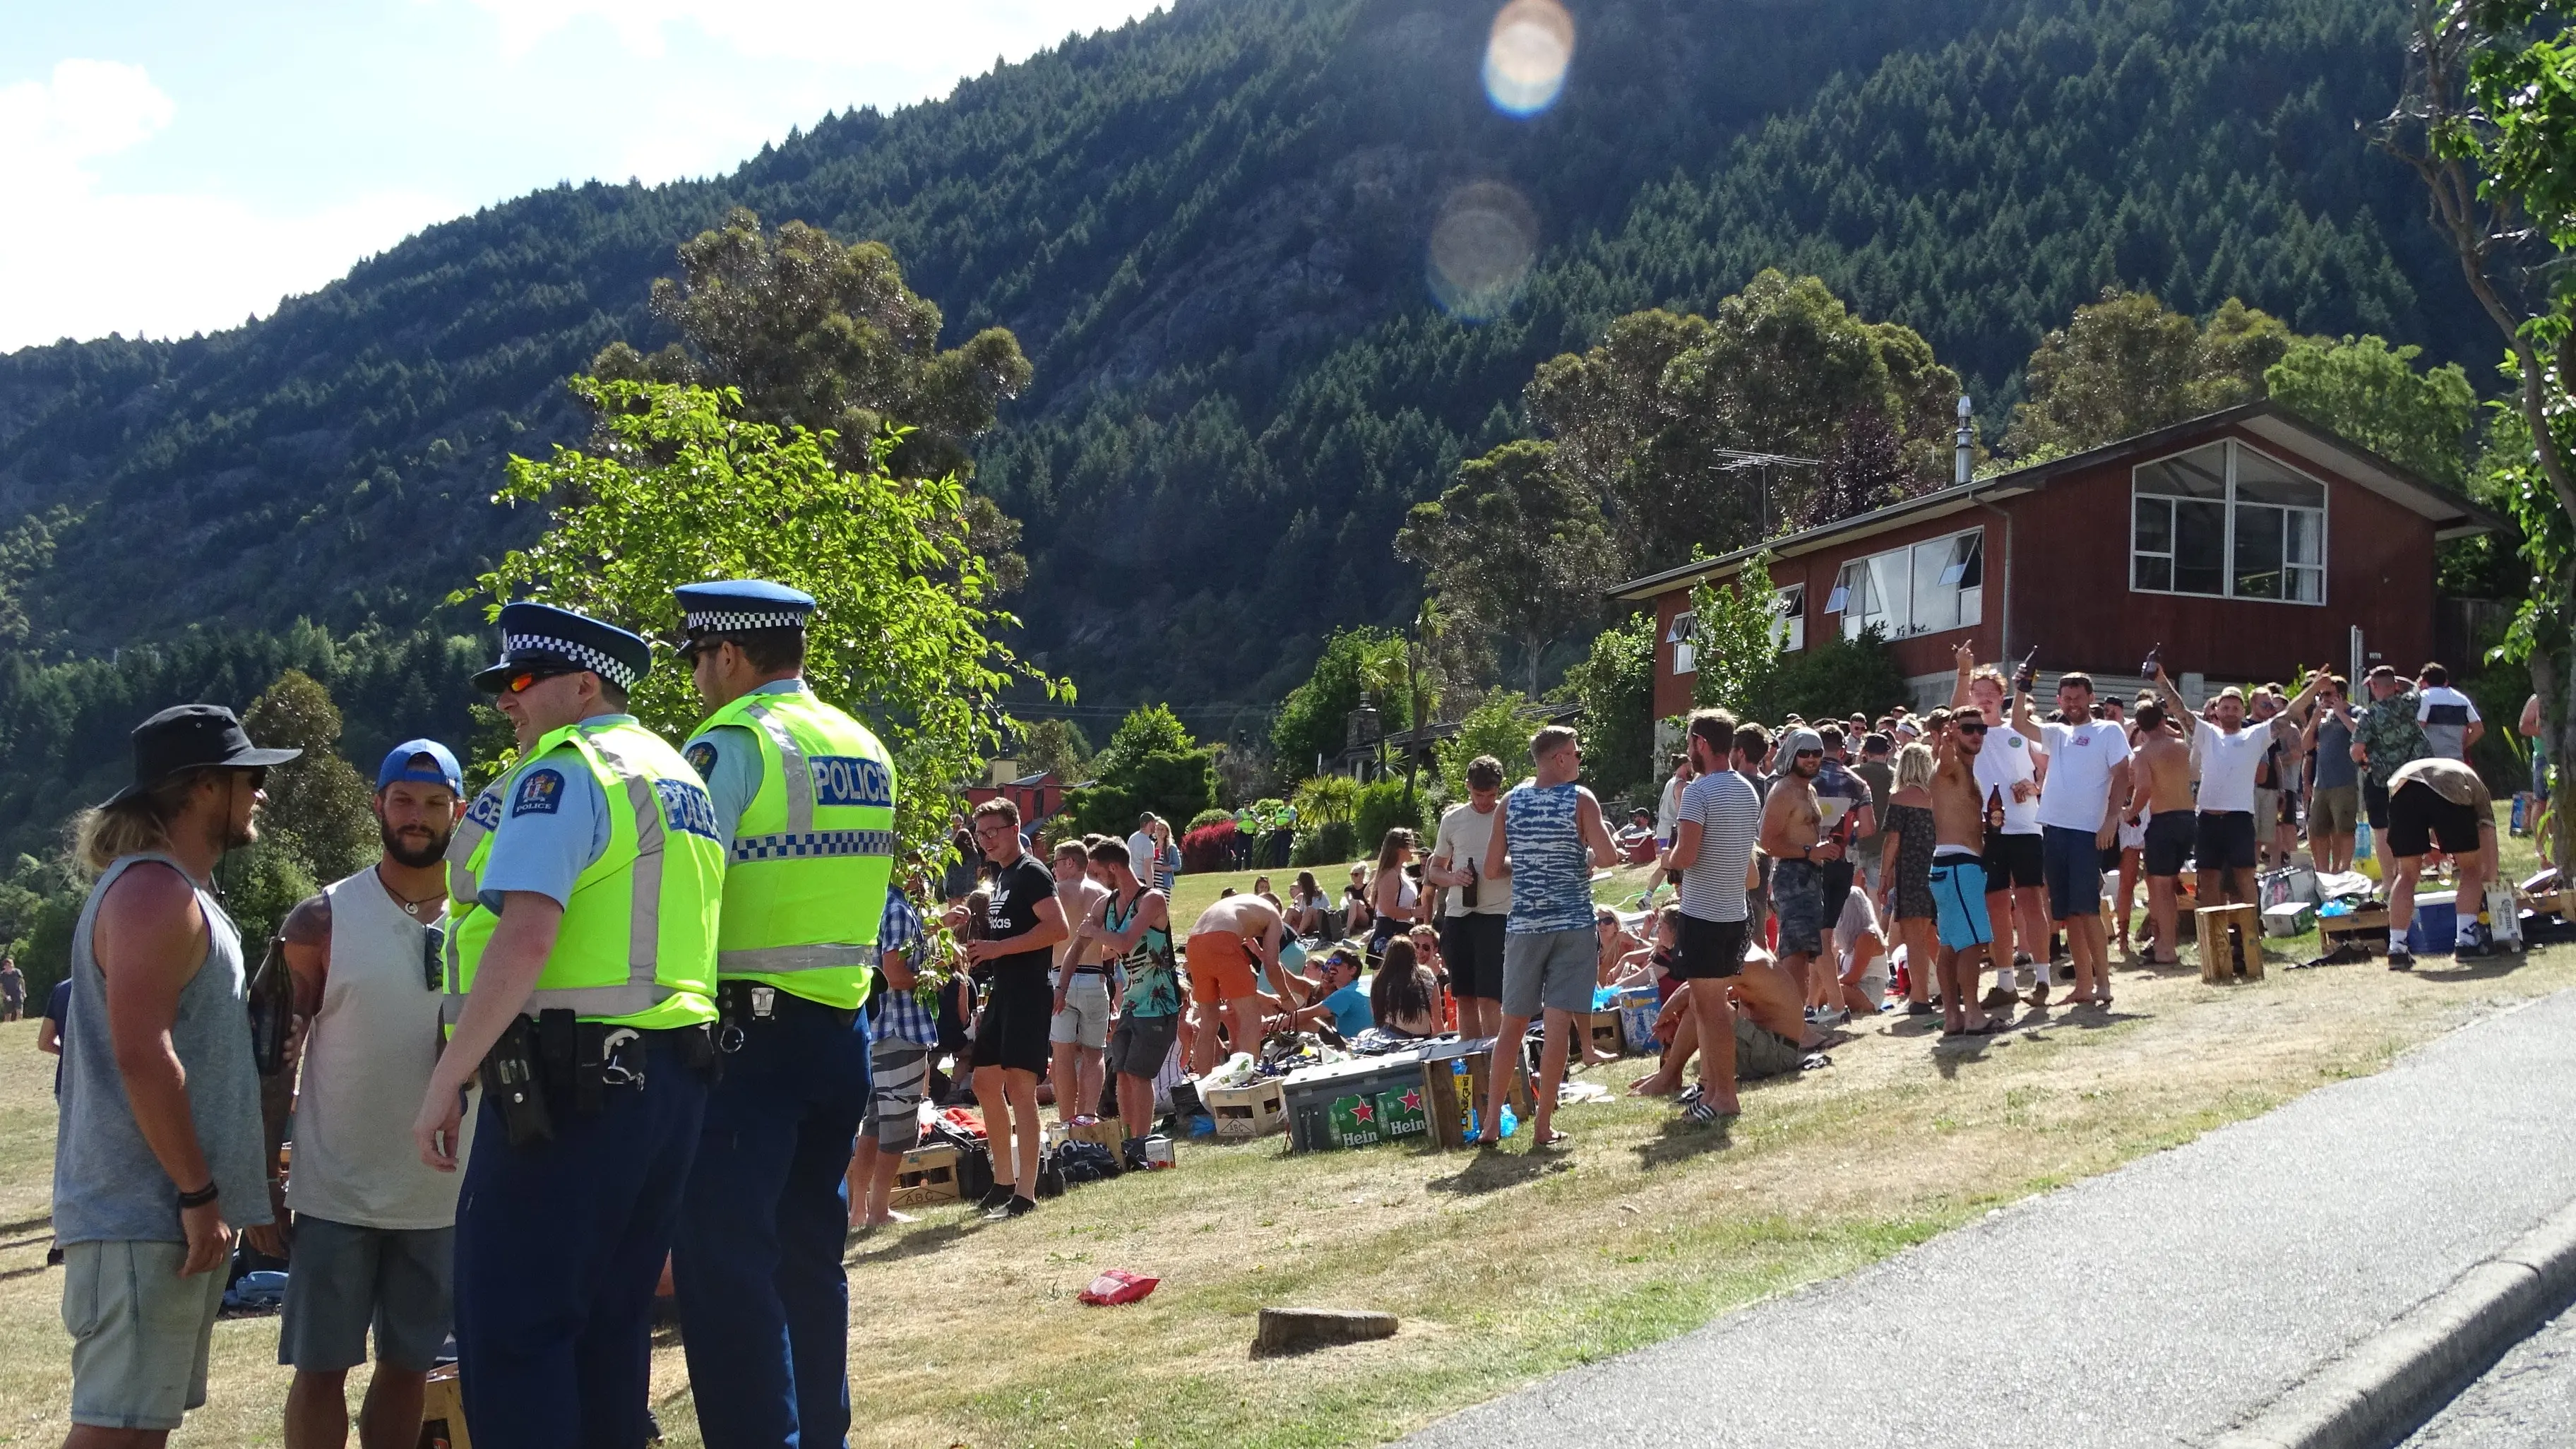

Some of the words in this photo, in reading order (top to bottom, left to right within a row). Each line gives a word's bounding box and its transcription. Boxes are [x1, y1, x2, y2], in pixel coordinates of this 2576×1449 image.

[811, 761, 891, 801] POLICE
[516, 803, 552, 813] POLICE
[1229, 1124, 1244, 1133] ABC
[1390, 1119, 1426, 1135] Hein
[1342, 1131, 1378, 1147] Hein
[906, 1191, 934, 1205] ABC
